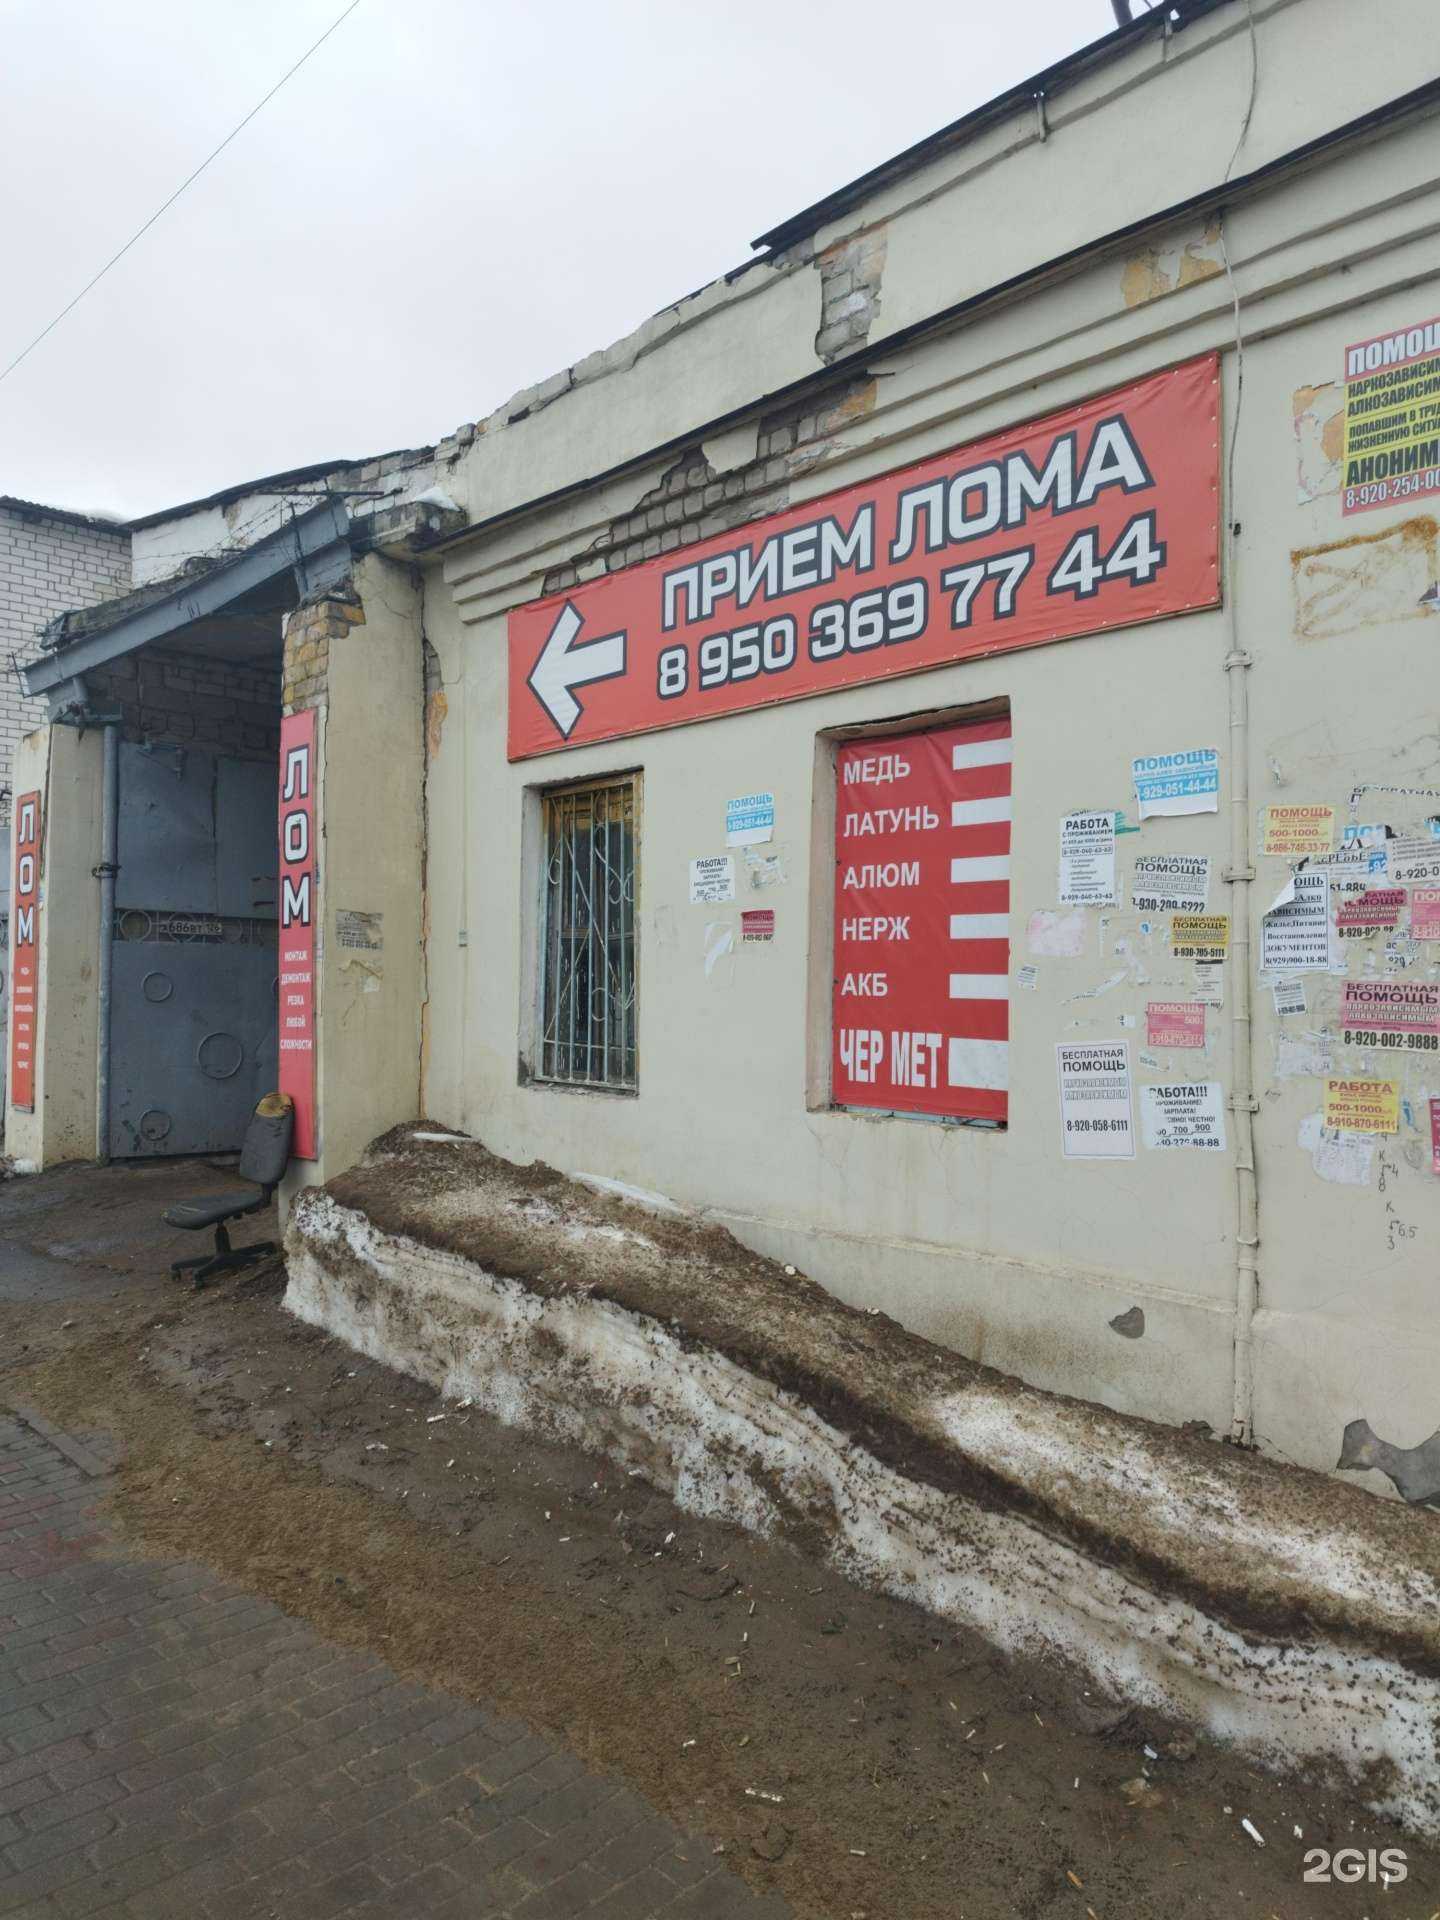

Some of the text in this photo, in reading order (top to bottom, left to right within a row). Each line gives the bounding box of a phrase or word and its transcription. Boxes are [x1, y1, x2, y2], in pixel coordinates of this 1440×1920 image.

[663, 414, 1156, 632] ПРИЕМ ЛОМА
[657, 510, 1167, 700] 8 950 369 77 44
[843, 755, 910, 786] МЕДЬ
[1134, 749, 1216, 771] ПОМОЩЬ
[843, 805, 939, 838] ЛАТУНЬ
[1270, 807, 1332, 818] ПОМОЩЬ
[1065, 817, 1109, 831] РАБОТА
[282, 744, 311, 928] ЛОМ
[17, 801, 34, 947] ЛОМ
[843, 861, 920, 890] АЛЮМ
[1135, 862, 1207, 875] ПОМОЩЬ
[842, 916, 910, 941] НЕРЖ
[1173, 922, 1226, 930] ПОМОЩЬ
[841, 973, 887, 997] АКБ
[1347, 983, 1438, 993] БЕСПЛАТНАЯ
[1346, 991, 1438, 1005] ПОМОЩЬ
[1344, 1030, 1438, 1050] 8-920-002-9888
[840, 1029, 942, 1088] ЧЕР МЕТ
[1062, 1049, 1123, 1060] БЕСПЛАТНАЯ
[1063, 1060, 1126, 1072] ПОМОЩЬ
[1328, 1081, 1392, 1093] РАБОТА
